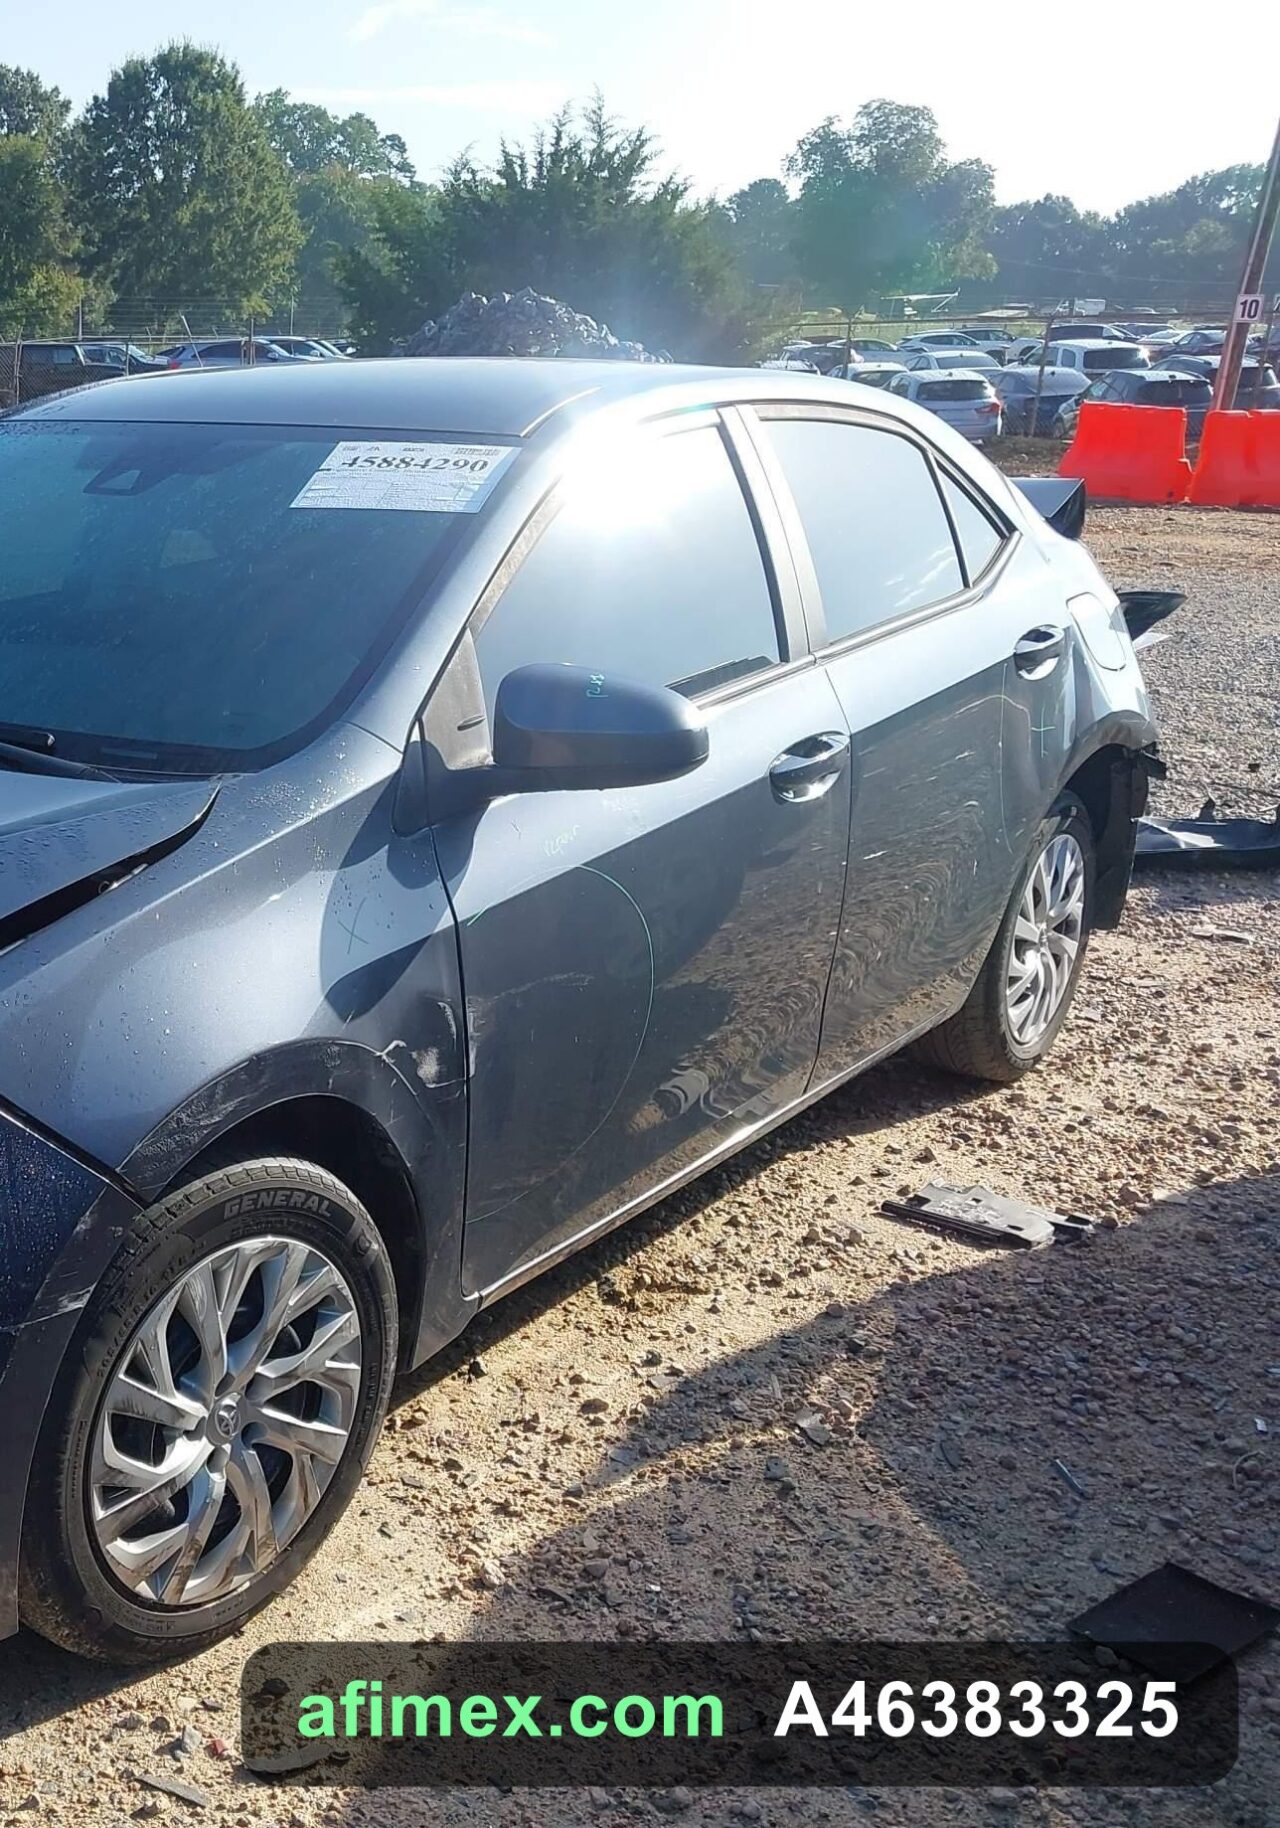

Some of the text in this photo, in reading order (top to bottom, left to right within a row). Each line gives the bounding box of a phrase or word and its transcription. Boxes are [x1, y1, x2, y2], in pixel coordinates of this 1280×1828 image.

[1239, 299, 1260, 319] 10
[341, 455, 489, 472] 45884290
[223, 1189, 332, 1219] GENERAL
